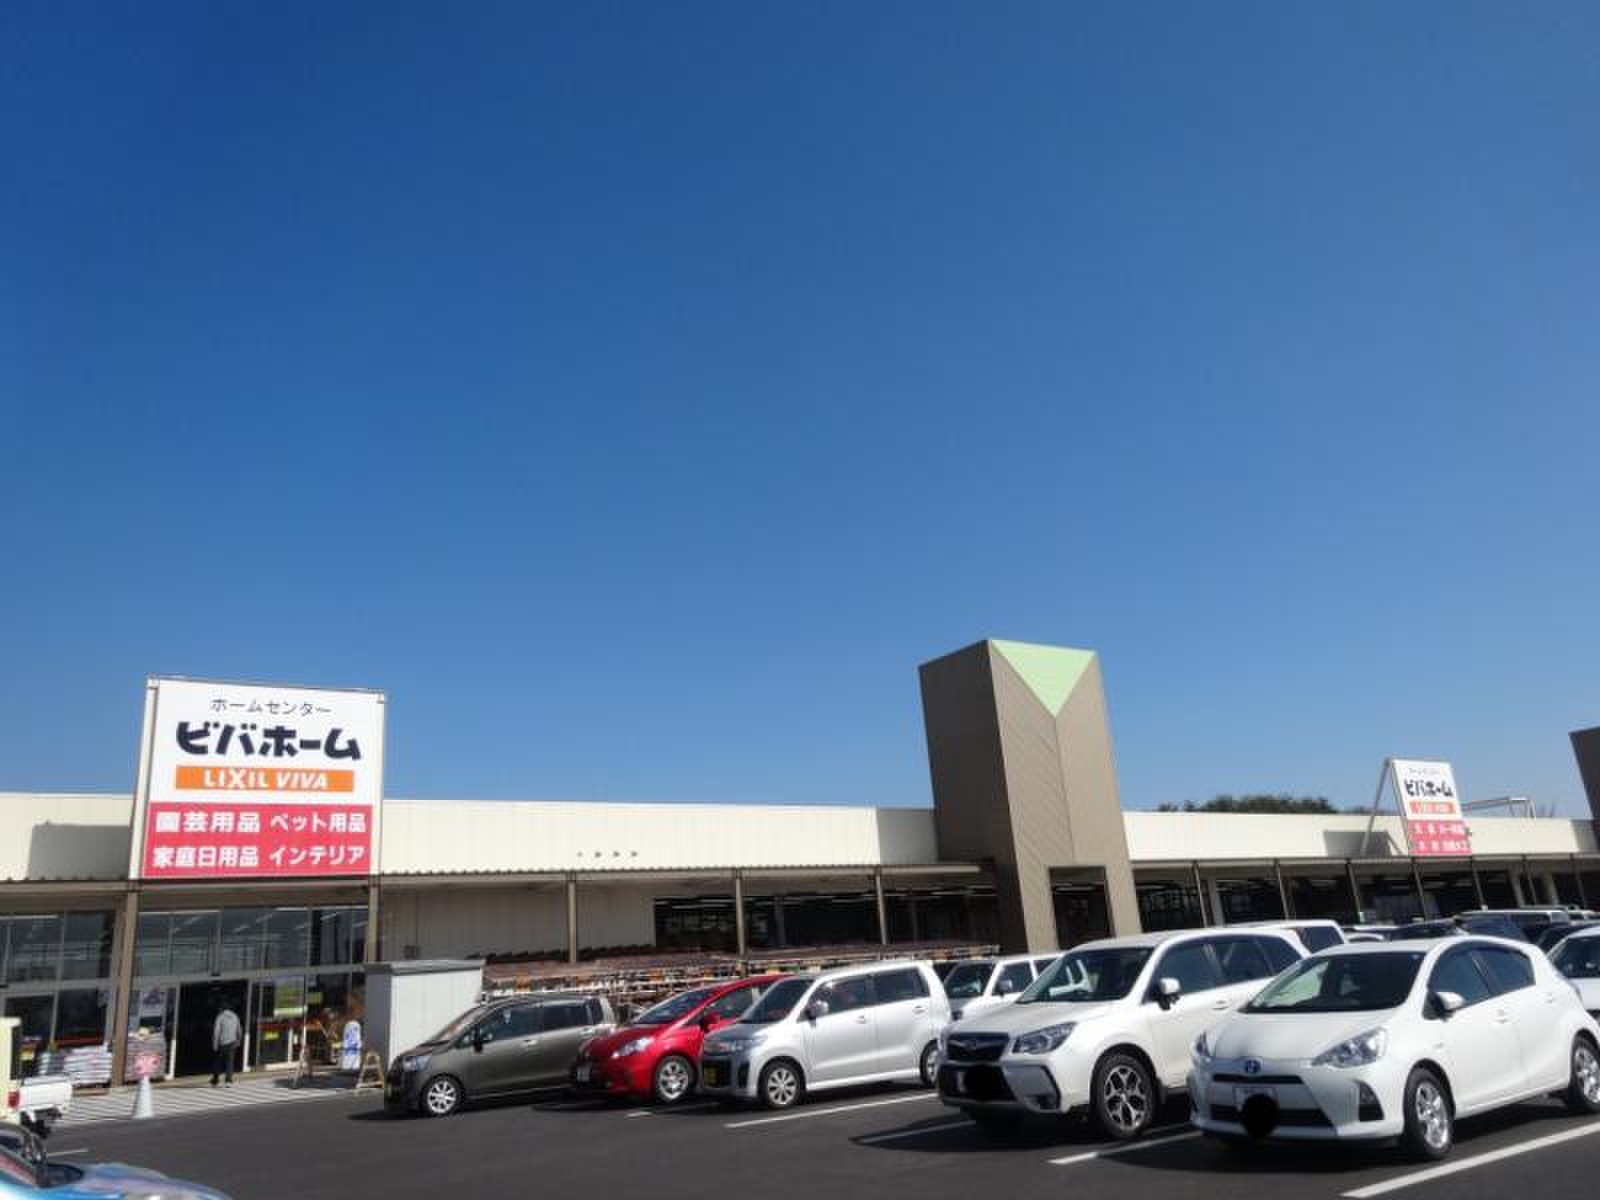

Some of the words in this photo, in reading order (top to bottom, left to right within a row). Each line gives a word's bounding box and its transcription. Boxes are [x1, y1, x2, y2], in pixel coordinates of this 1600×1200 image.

[210, 698, 332, 717] ホームセンター
[176, 721, 362, 761] ビバホーム
[203, 768, 270, 789] LIXIL
[276, 770, 329, 790] VIVA
[269, 812, 367, 833] ペット用品
[152, 846, 259, 869] 家庭日用品
[268, 845, 366, 868] インテリア
